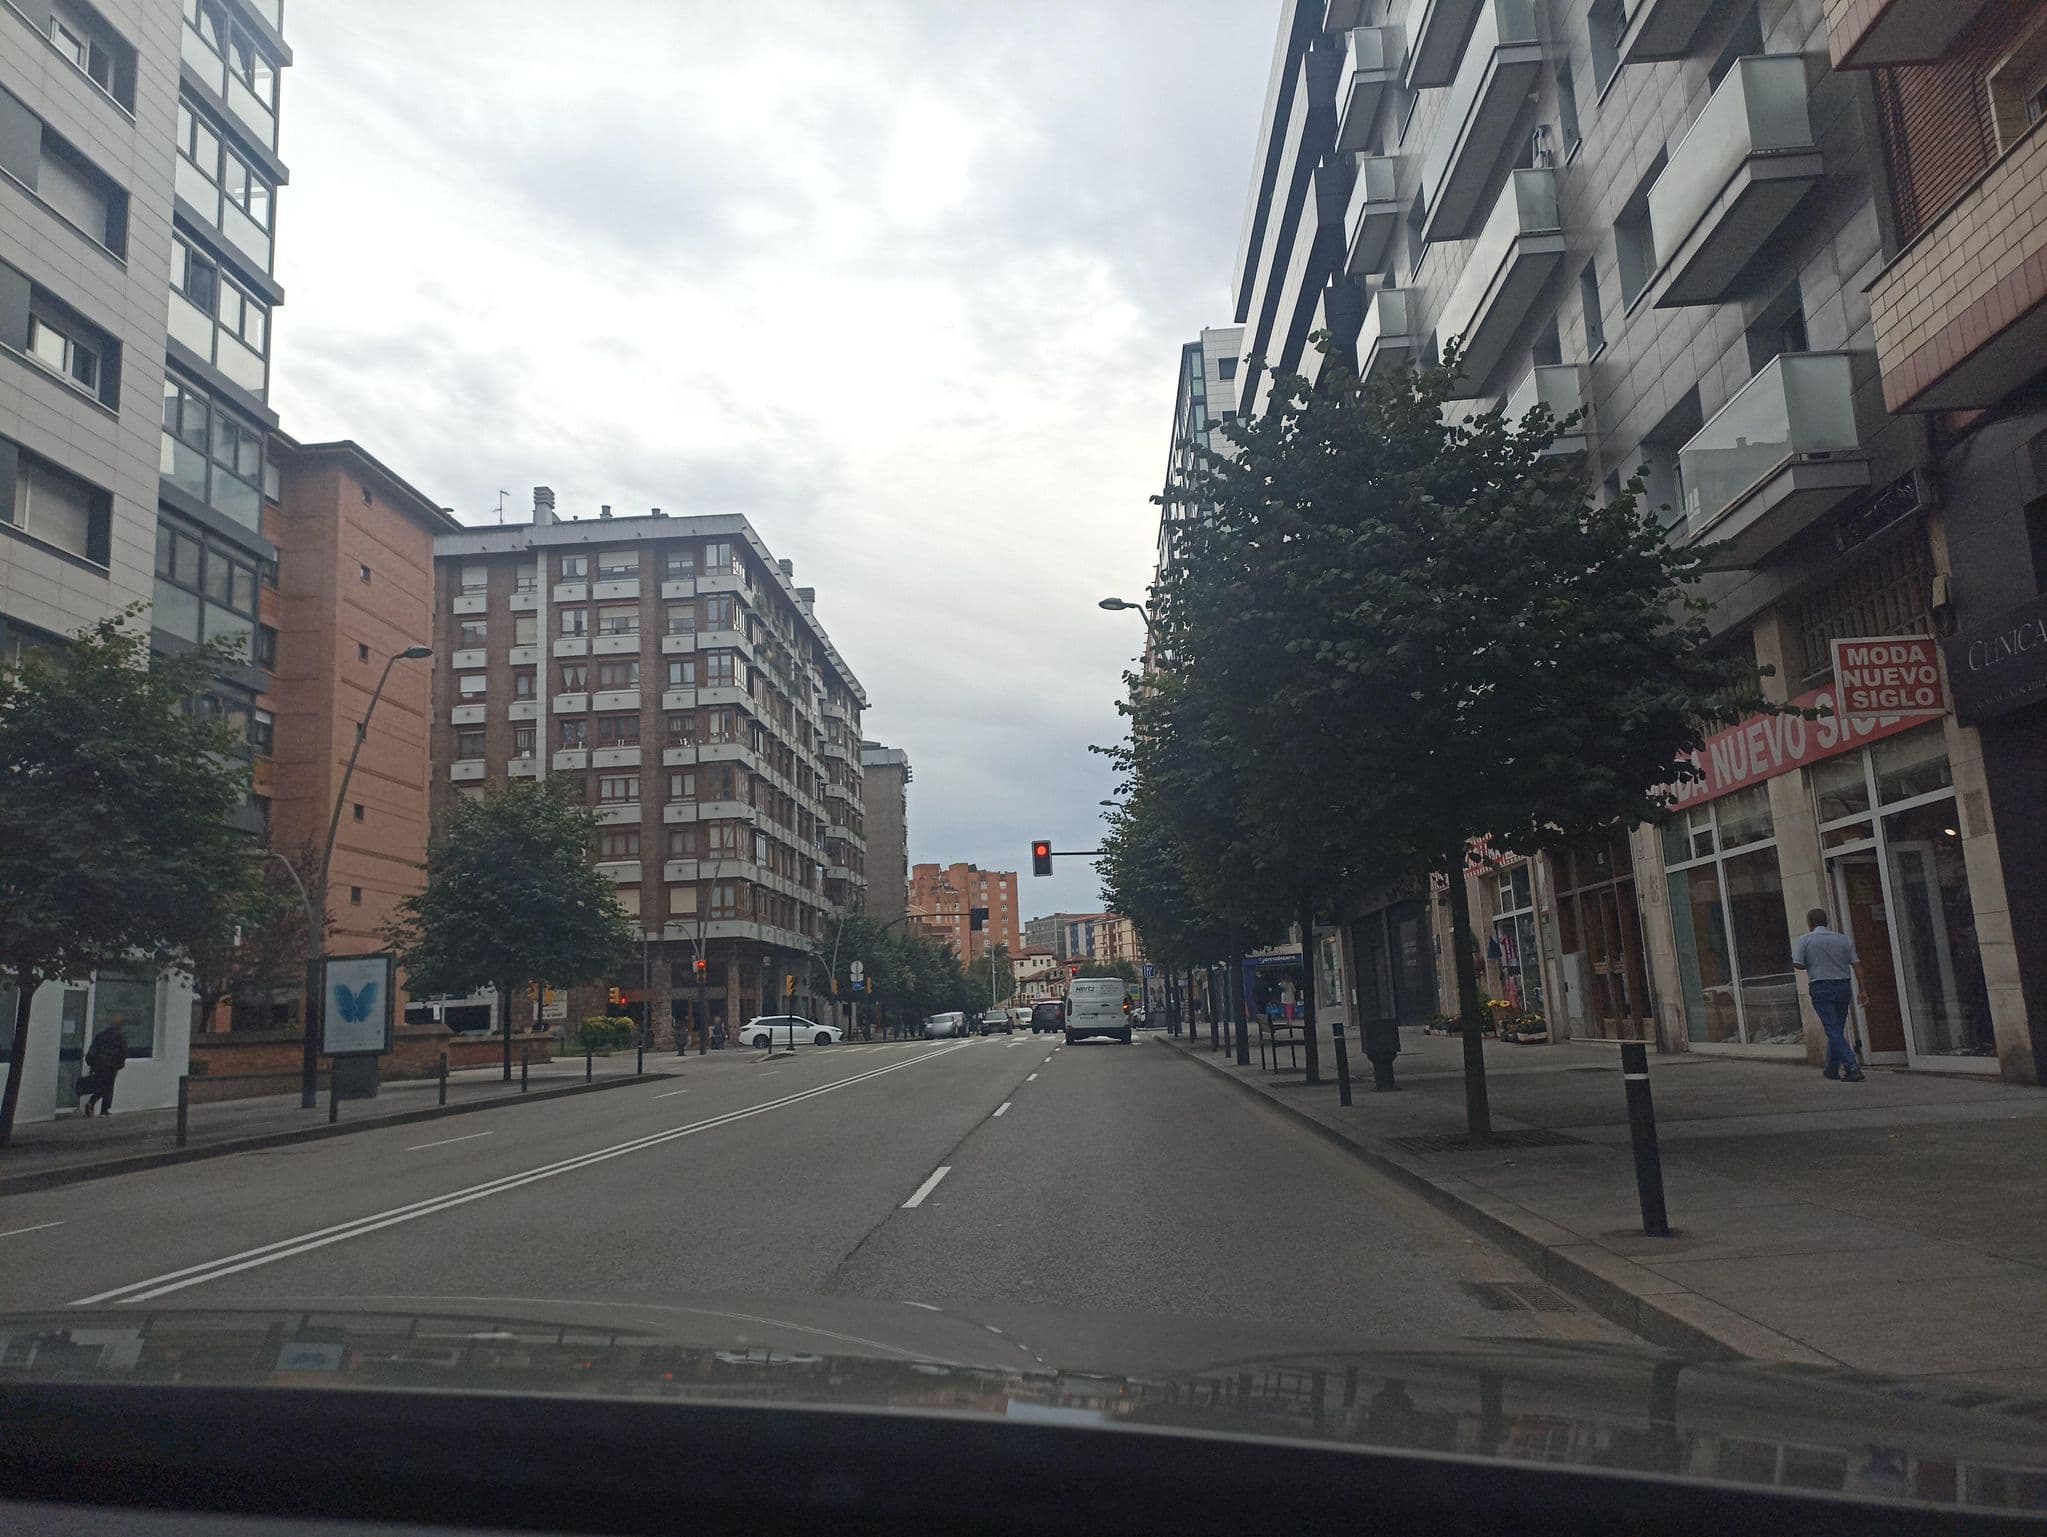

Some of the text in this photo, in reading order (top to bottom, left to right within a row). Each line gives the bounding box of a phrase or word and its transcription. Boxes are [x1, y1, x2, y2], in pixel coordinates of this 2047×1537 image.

[1846, 645, 1928, 666] MODA
[1842, 665, 1937, 688] NUEVO
[1852, 687, 1935, 709] SIGLO
[1710, 714, 1807, 786] NUEVO
